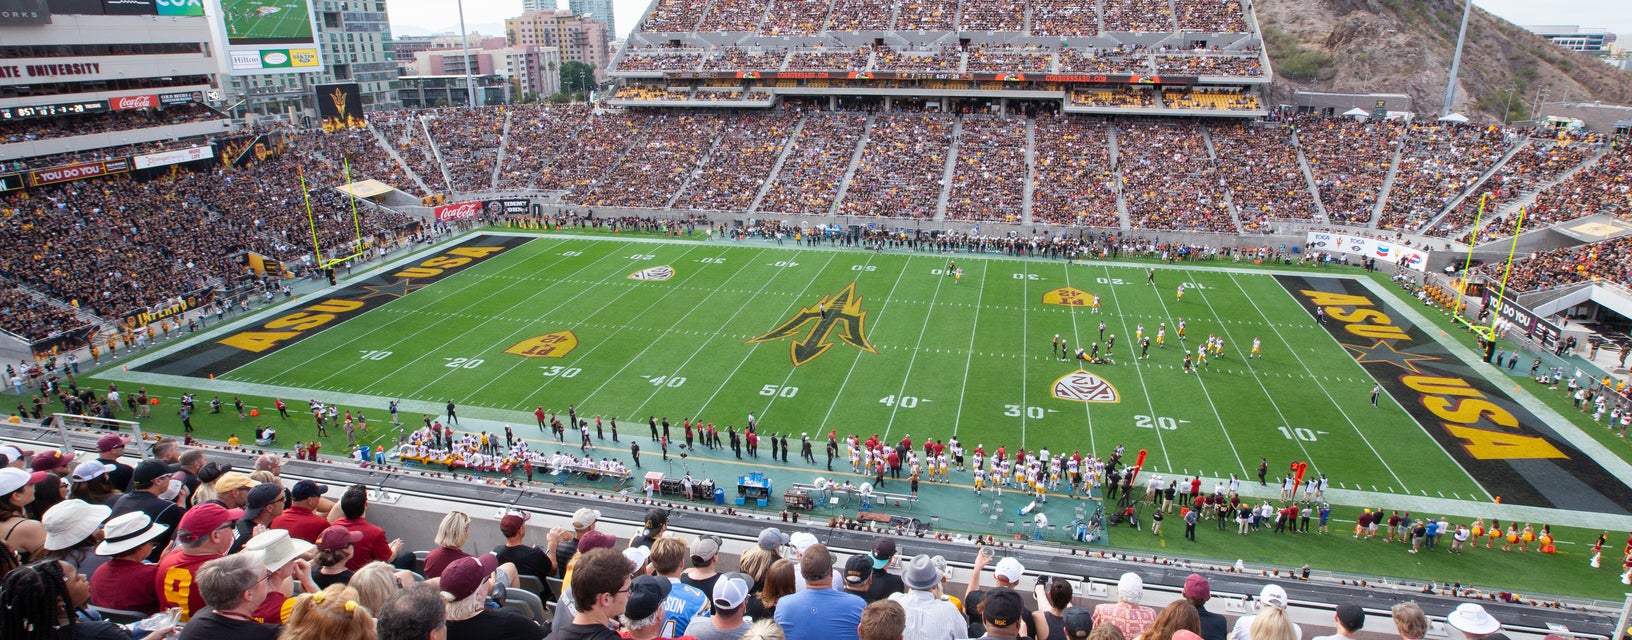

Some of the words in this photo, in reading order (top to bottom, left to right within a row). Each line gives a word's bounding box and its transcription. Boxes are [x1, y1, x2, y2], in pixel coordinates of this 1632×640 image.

[26, 62, 100, 77] UNIVERSITY
[40, 172, 62, 181] YOU
[64, 169, 79, 178] DO
[80, 166, 100, 175] YOU
[392, 246, 505, 278] USA
[1300, 289, 1412, 341] ASU
[1490, 296, 1504, 311] YOU
[1503, 304, 1514, 318] DO
[1515, 310, 1530, 326] YOU
[216, 299, 365, 353] ASU
[361, 350, 392, 360] 10
[444, 358, 484, 368] 20
[543, 366, 582, 378] 30
[649, 376, 686, 388] 40
[759, 384, 799, 398] 50
[879, 395, 918, 408] 40
[1004, 404, 1044, 419] 30
[1400, 374, 1572, 460] USA
[1134, 415, 1178, 430] 20
[1278, 426, 1318, 442] 10
[164, 567, 192, 622] 9
